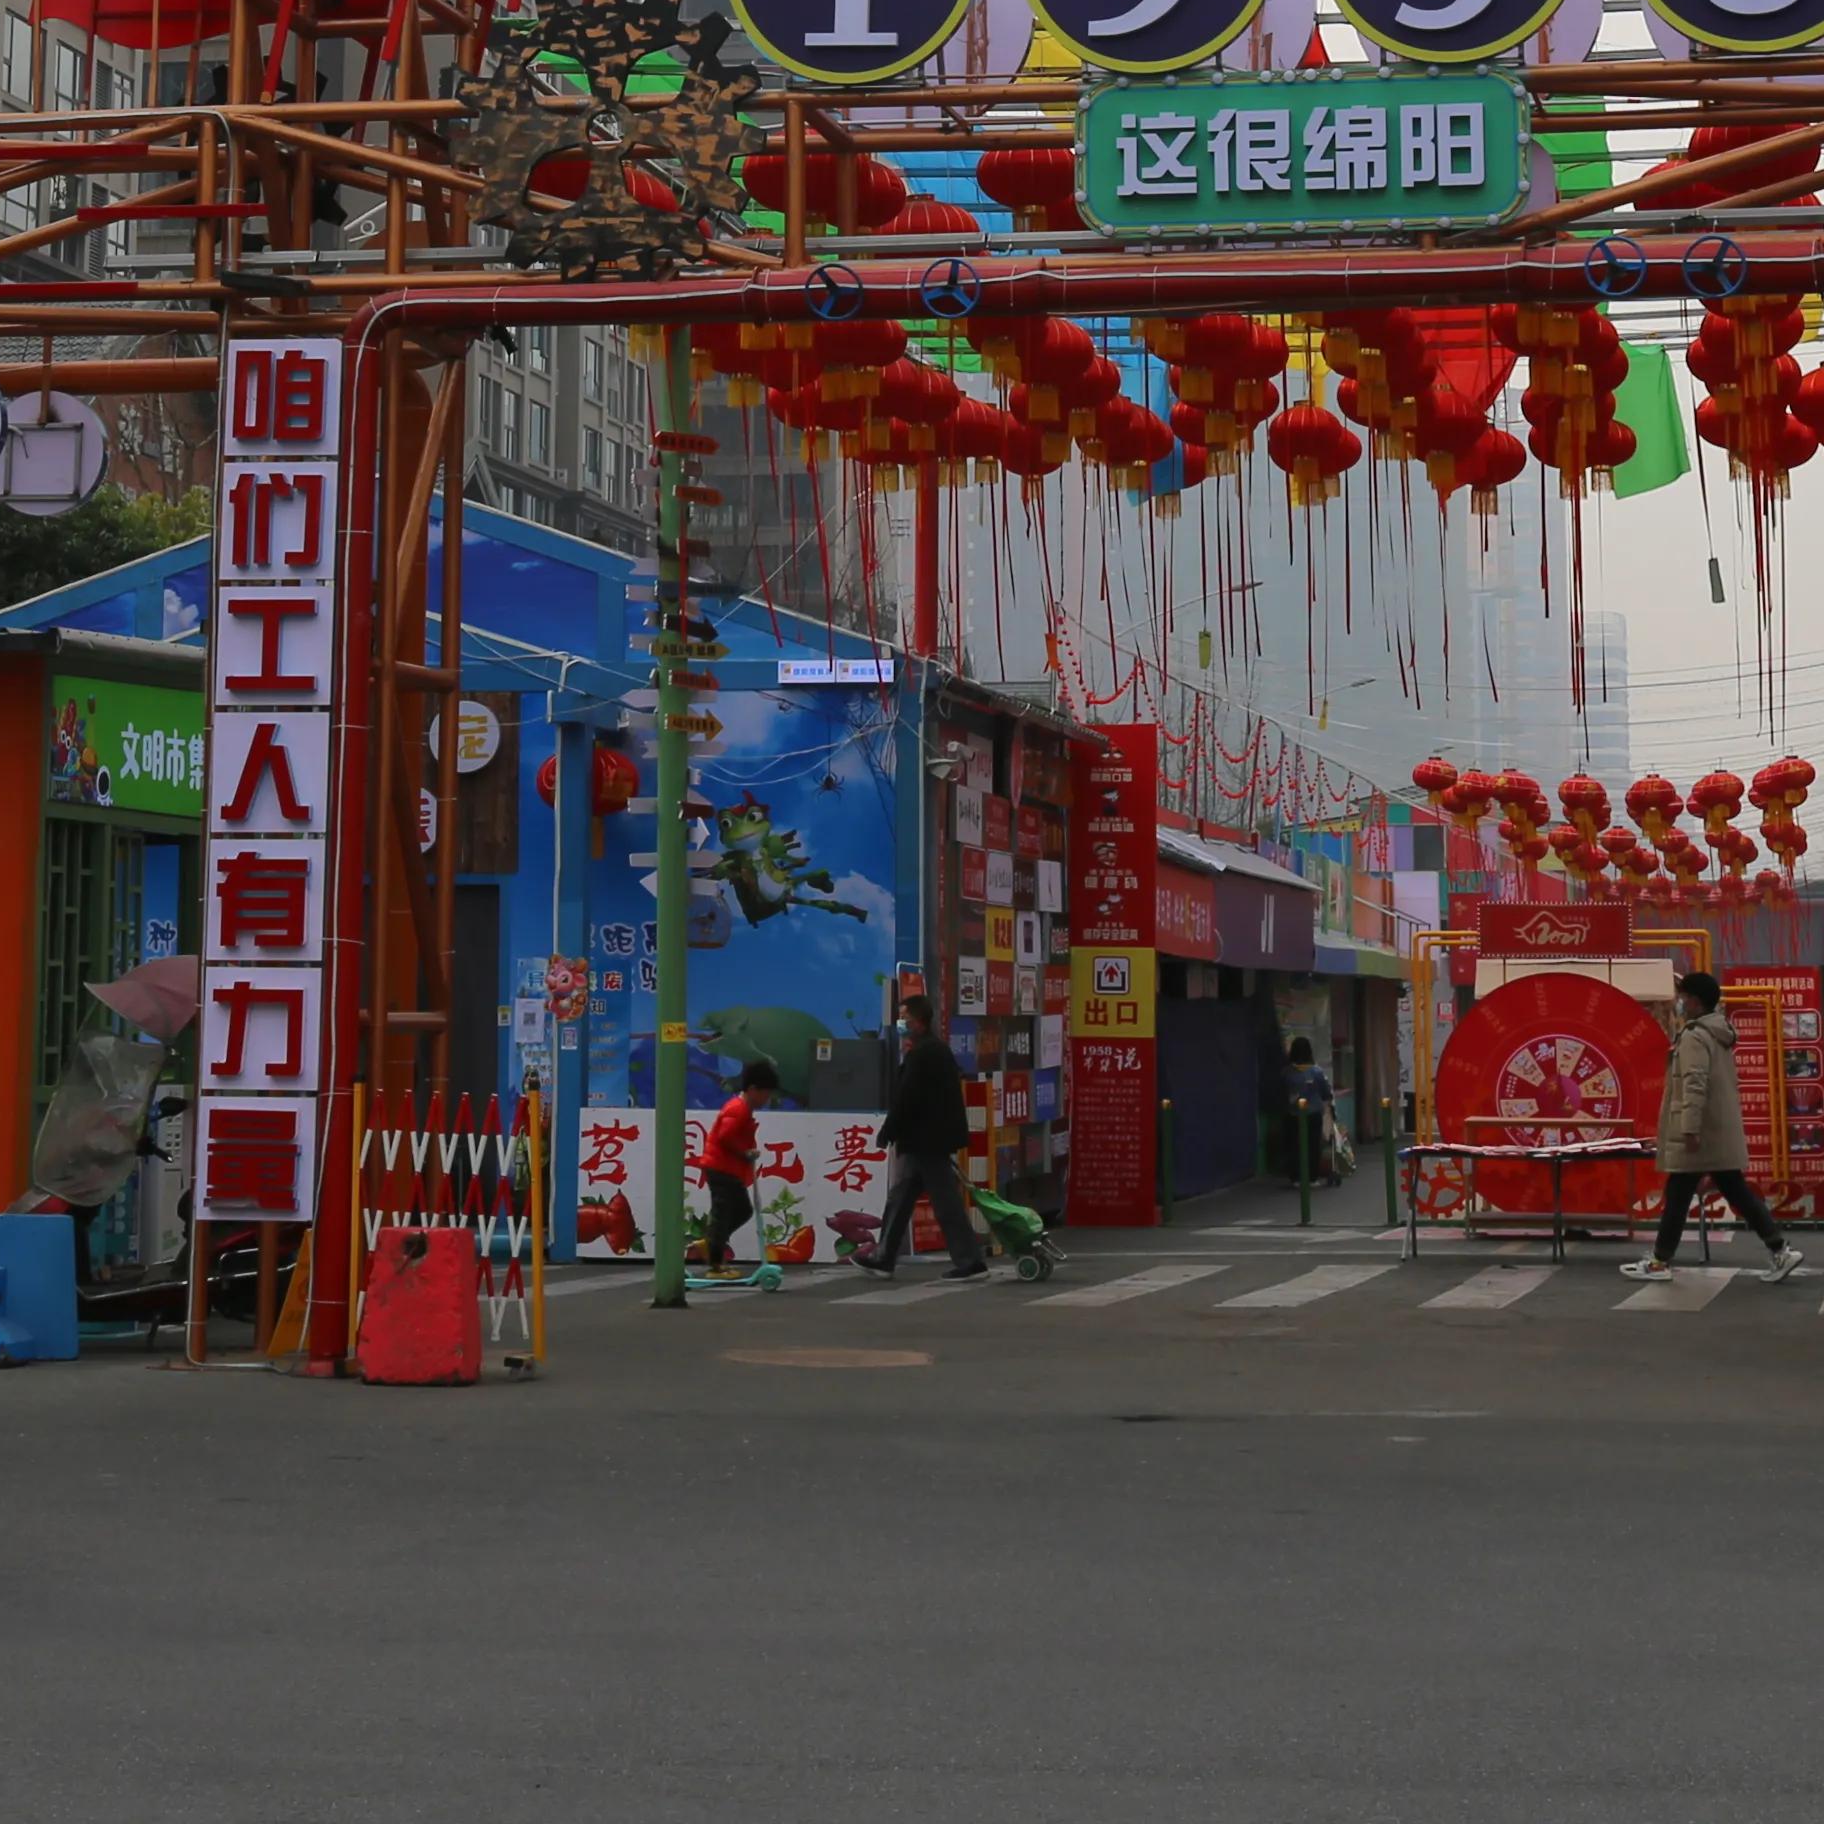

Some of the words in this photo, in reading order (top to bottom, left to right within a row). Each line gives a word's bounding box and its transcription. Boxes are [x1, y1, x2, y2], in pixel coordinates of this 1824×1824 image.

[1115, 102, 1485, 196] 这很绵阳
[206, 349, 327, 1211] 咱们工人有力量
[1084, 997, 1139, 1027] 出口
[1081, 1045, 1113, 1057] 1958
